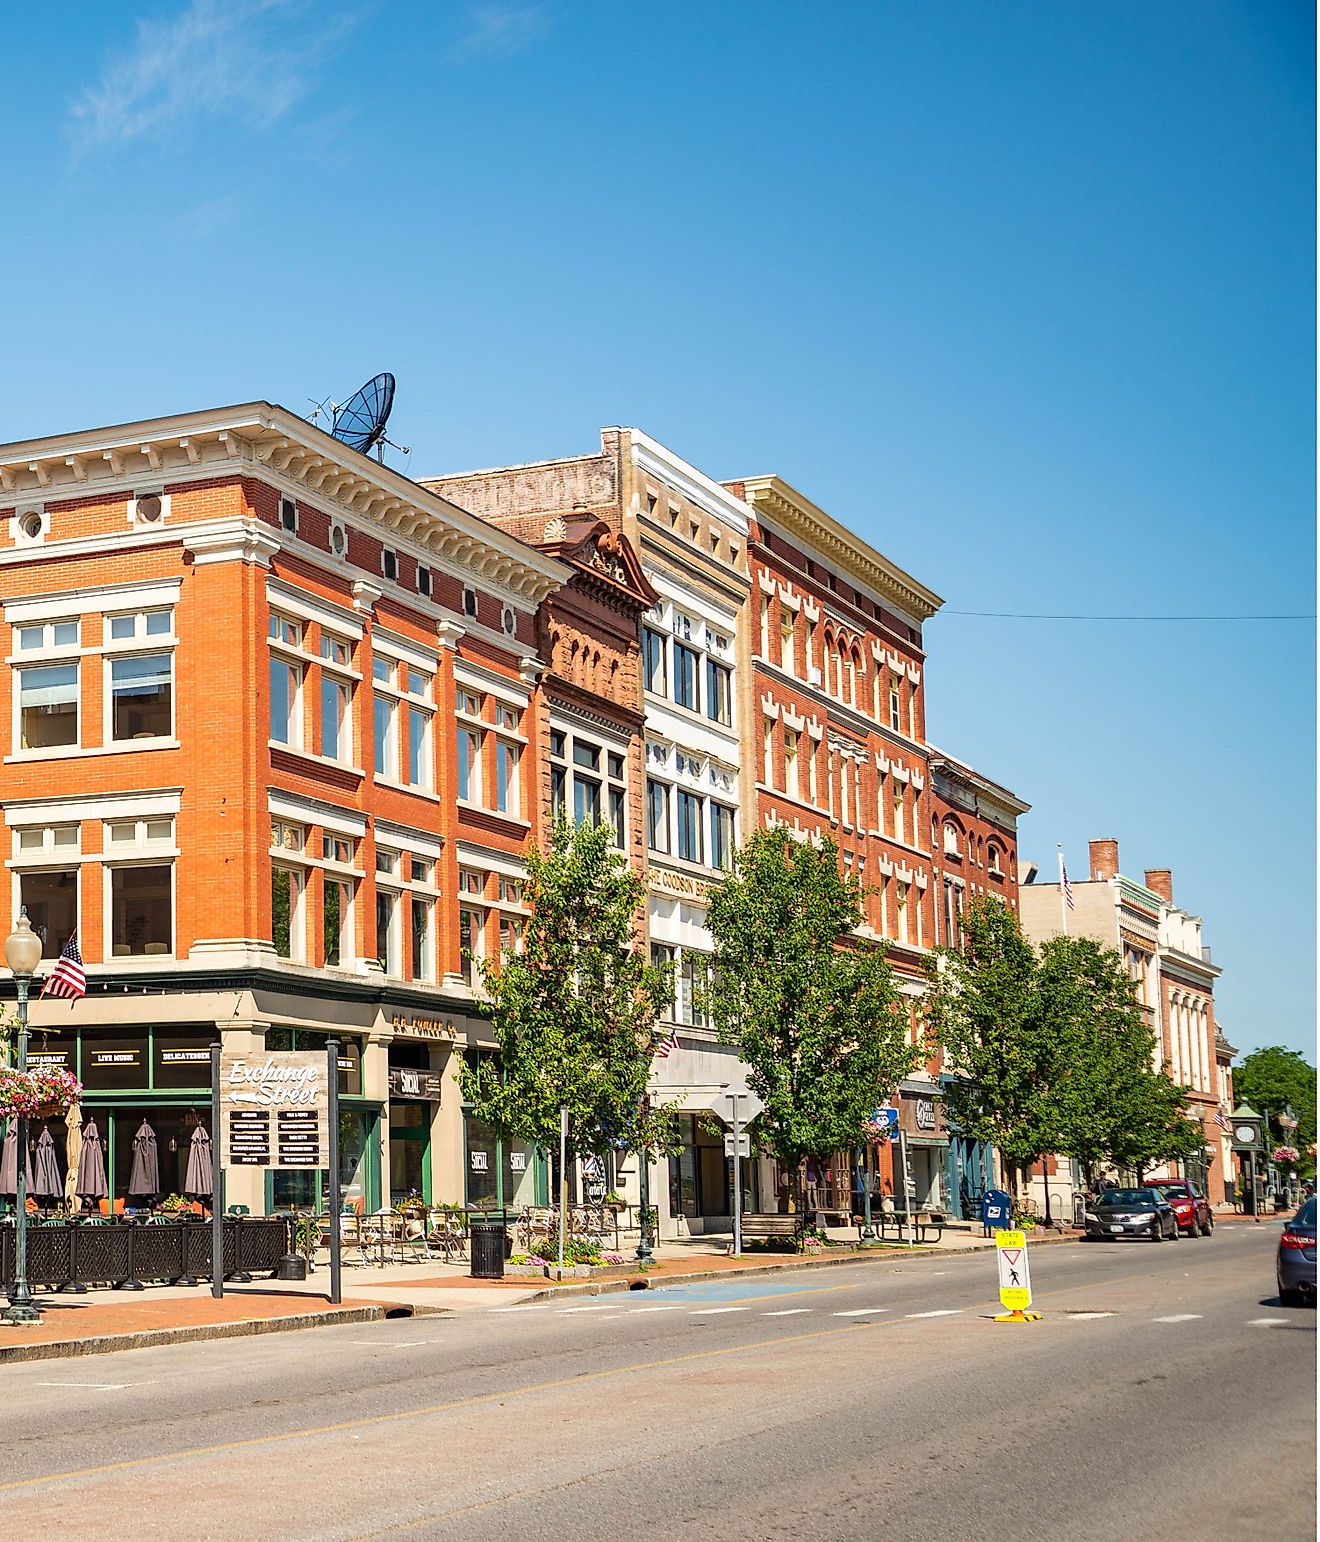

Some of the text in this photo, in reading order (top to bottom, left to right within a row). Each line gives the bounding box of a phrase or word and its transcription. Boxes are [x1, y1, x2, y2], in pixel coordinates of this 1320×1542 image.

[114, 1054, 134, 1062] MUSIC
[163, 1052, 210, 1060] DELICATESSEN
[228, 1057, 318, 1088] Exchange
[257, 1082, 318, 1105] Street
